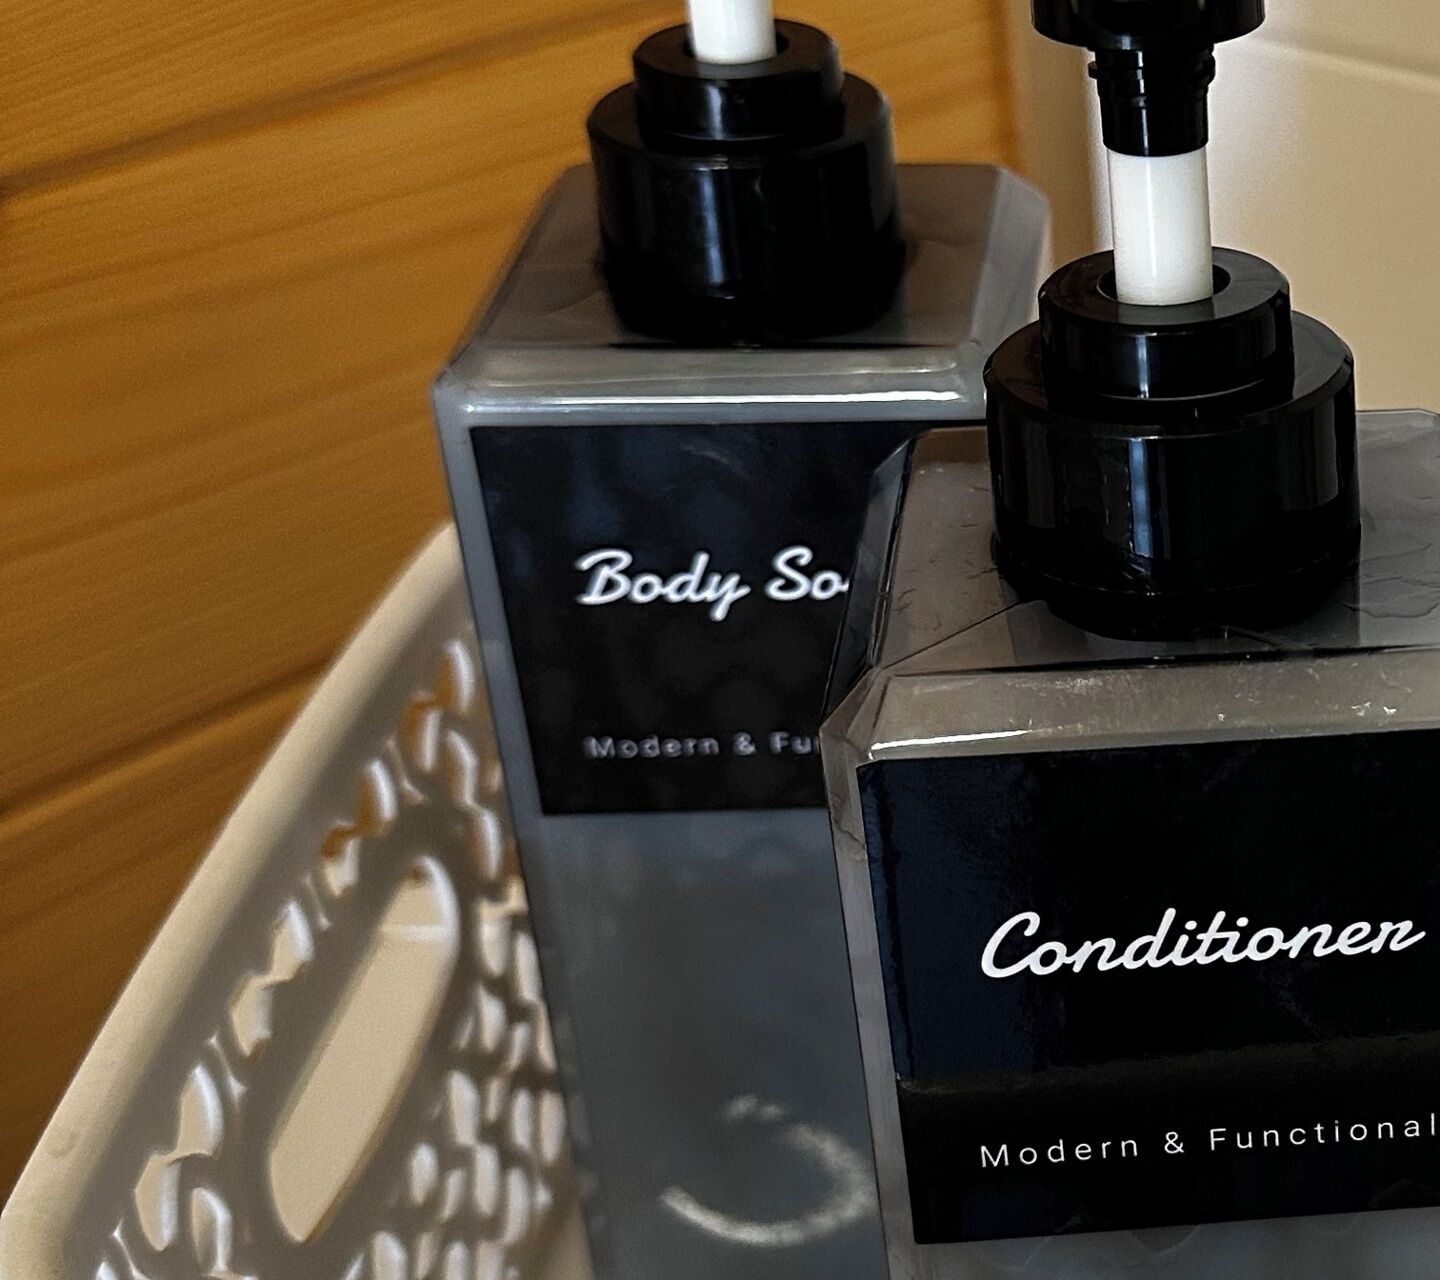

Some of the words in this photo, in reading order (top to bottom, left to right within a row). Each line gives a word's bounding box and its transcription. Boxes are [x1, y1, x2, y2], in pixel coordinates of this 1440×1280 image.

[574, 548, 752, 622] Body
[583, 734, 720, 759] Modern
[732, 732, 756, 755] &
[979, 906, 1427, 980] Conditioner
[979, 1136, 1139, 1169] Modern
[1163, 1130, 1186, 1155] &
[1208, 1111, 1437, 1152] Functional
